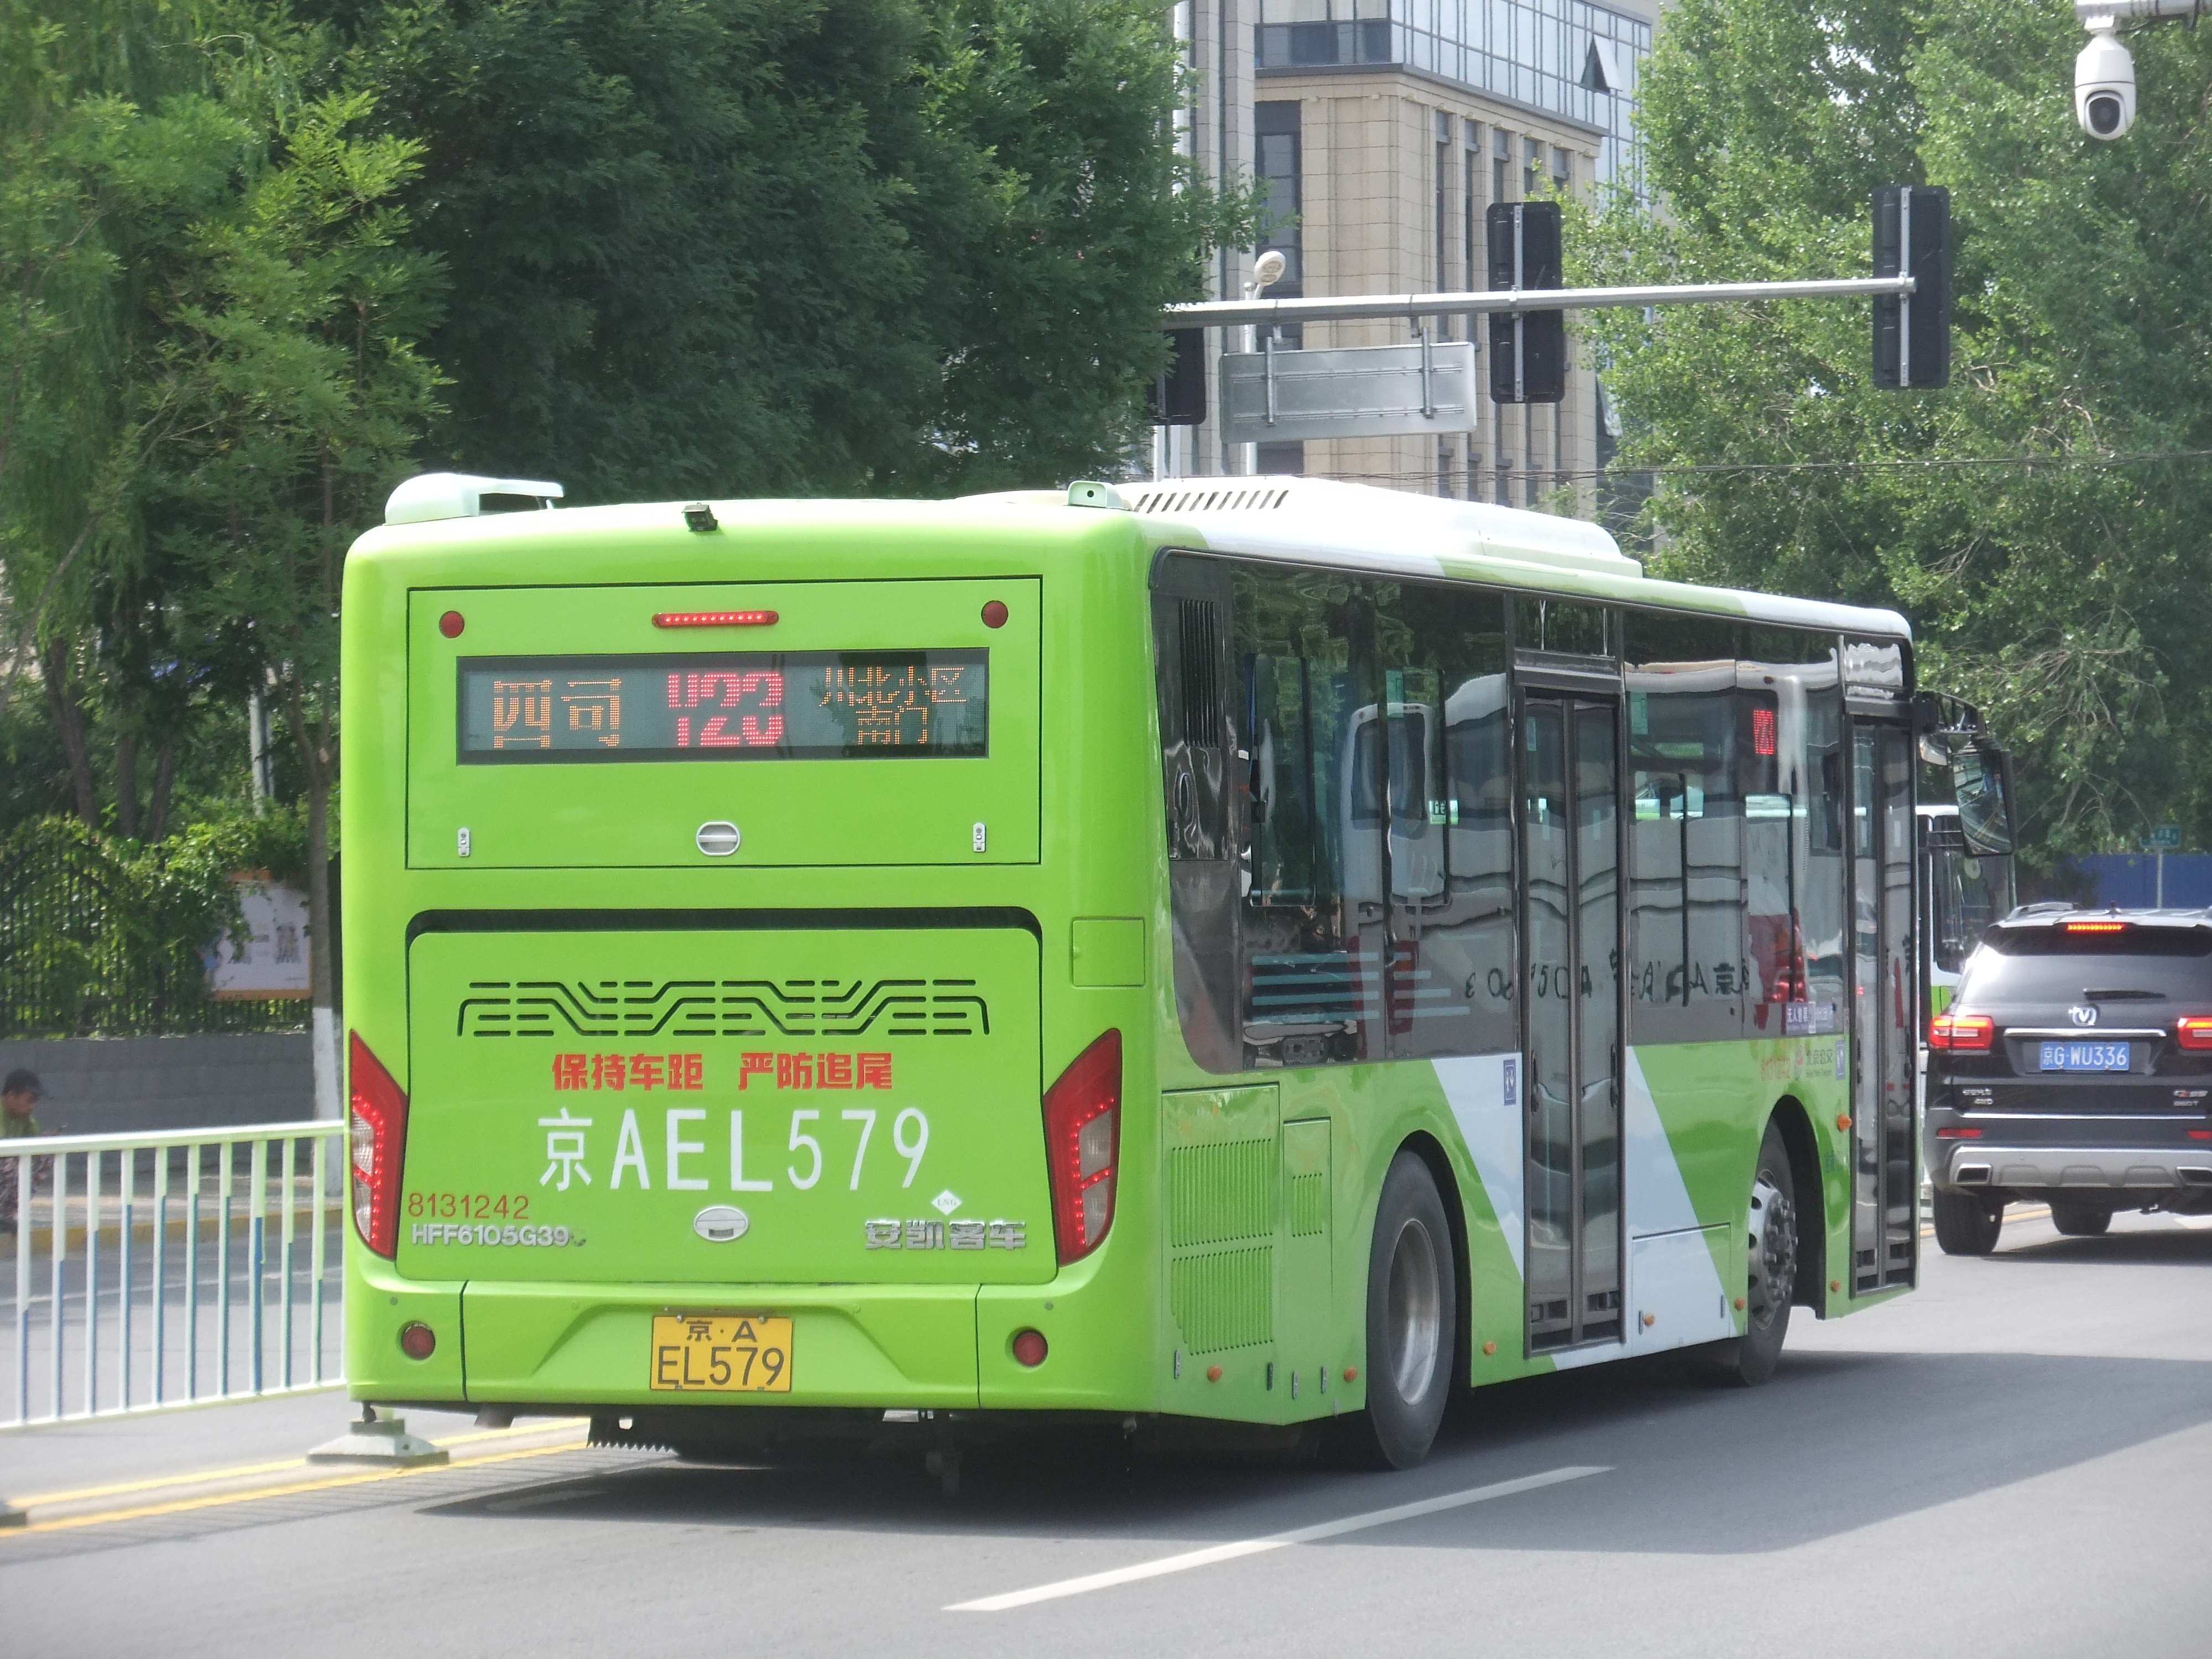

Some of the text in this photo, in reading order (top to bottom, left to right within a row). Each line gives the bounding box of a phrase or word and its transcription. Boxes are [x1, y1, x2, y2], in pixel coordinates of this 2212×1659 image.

[552, 1052, 893, 1091] 保持车距 严防追尾
[538, 1107, 930, 1192] 京AEL579
[408, 1192, 529, 1220] 8131242
[937, 1198, 957, 1207] LNG
[864, 1218, 1027, 1250] 安凯客车
[657, 1345, 785, 1386] EL579
